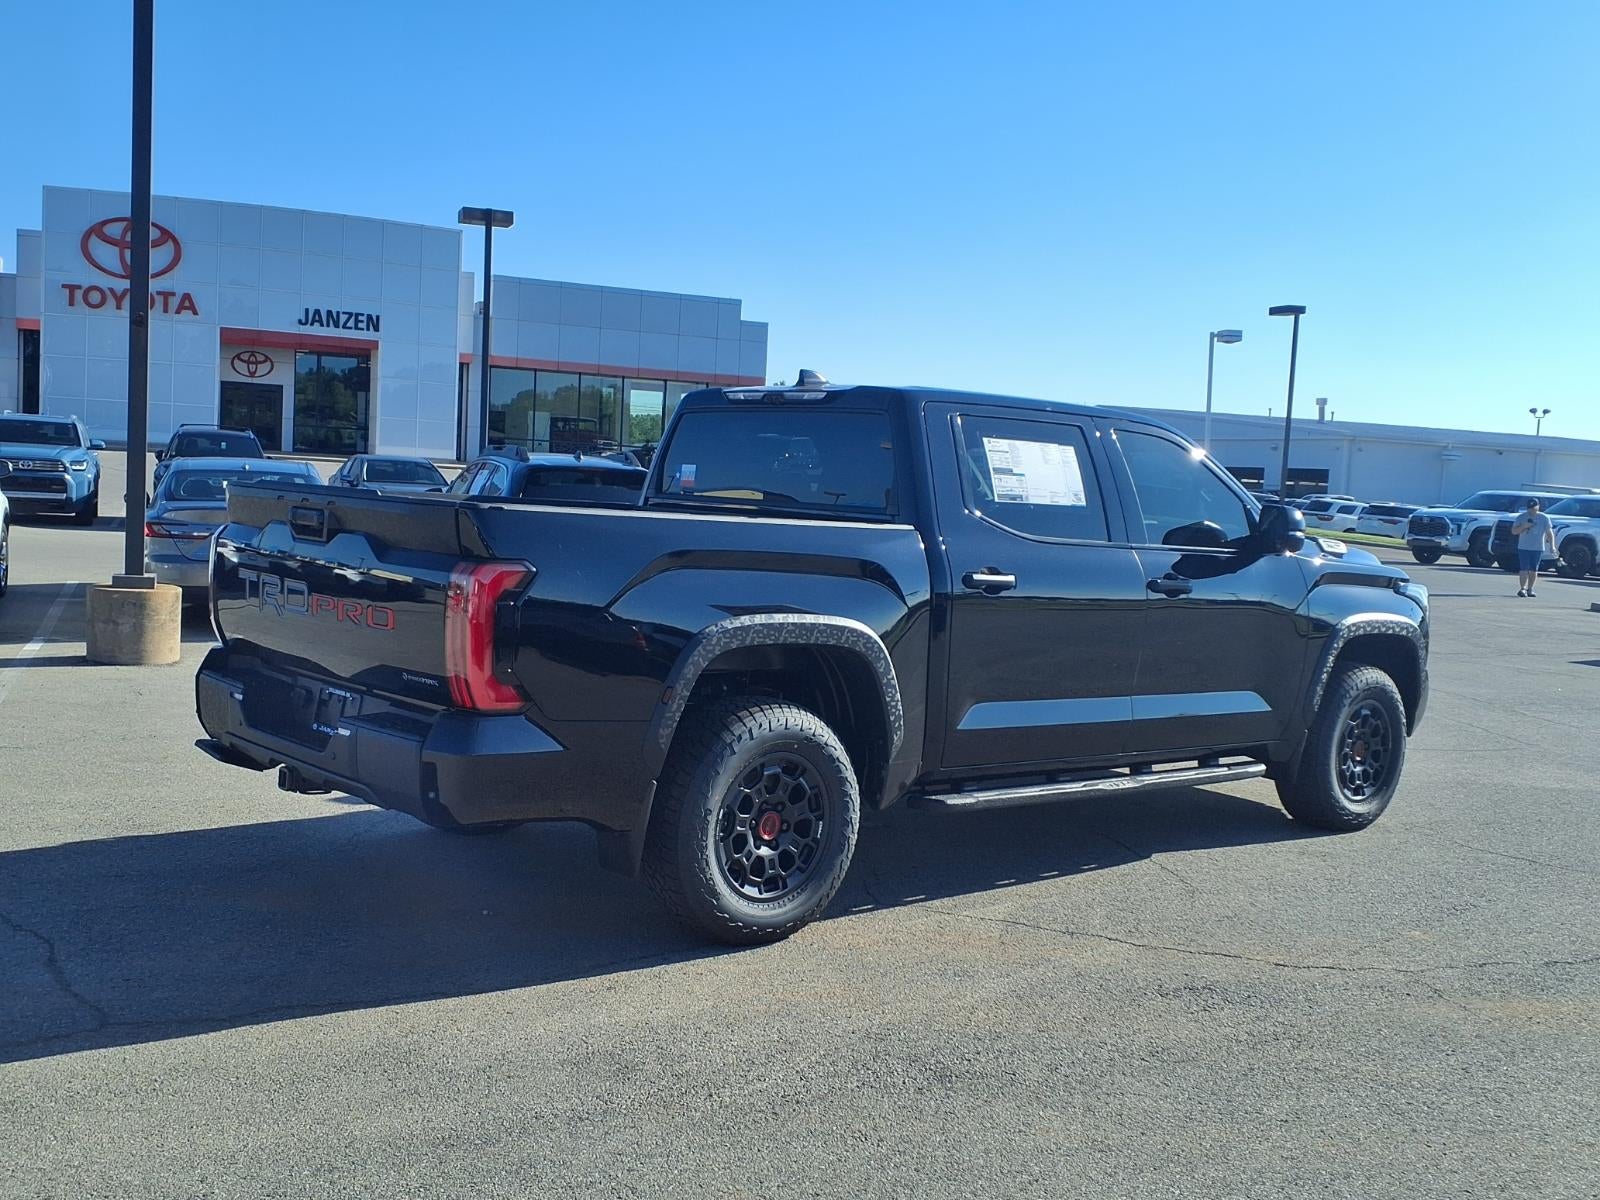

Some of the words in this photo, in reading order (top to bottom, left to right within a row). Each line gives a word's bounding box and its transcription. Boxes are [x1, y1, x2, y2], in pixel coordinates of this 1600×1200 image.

[61, 284, 199, 316] TOYTA
[298, 308, 380, 332] JANZEN
[237, 567, 309, 617] TRD
[311, 592, 396, 631] PRO
